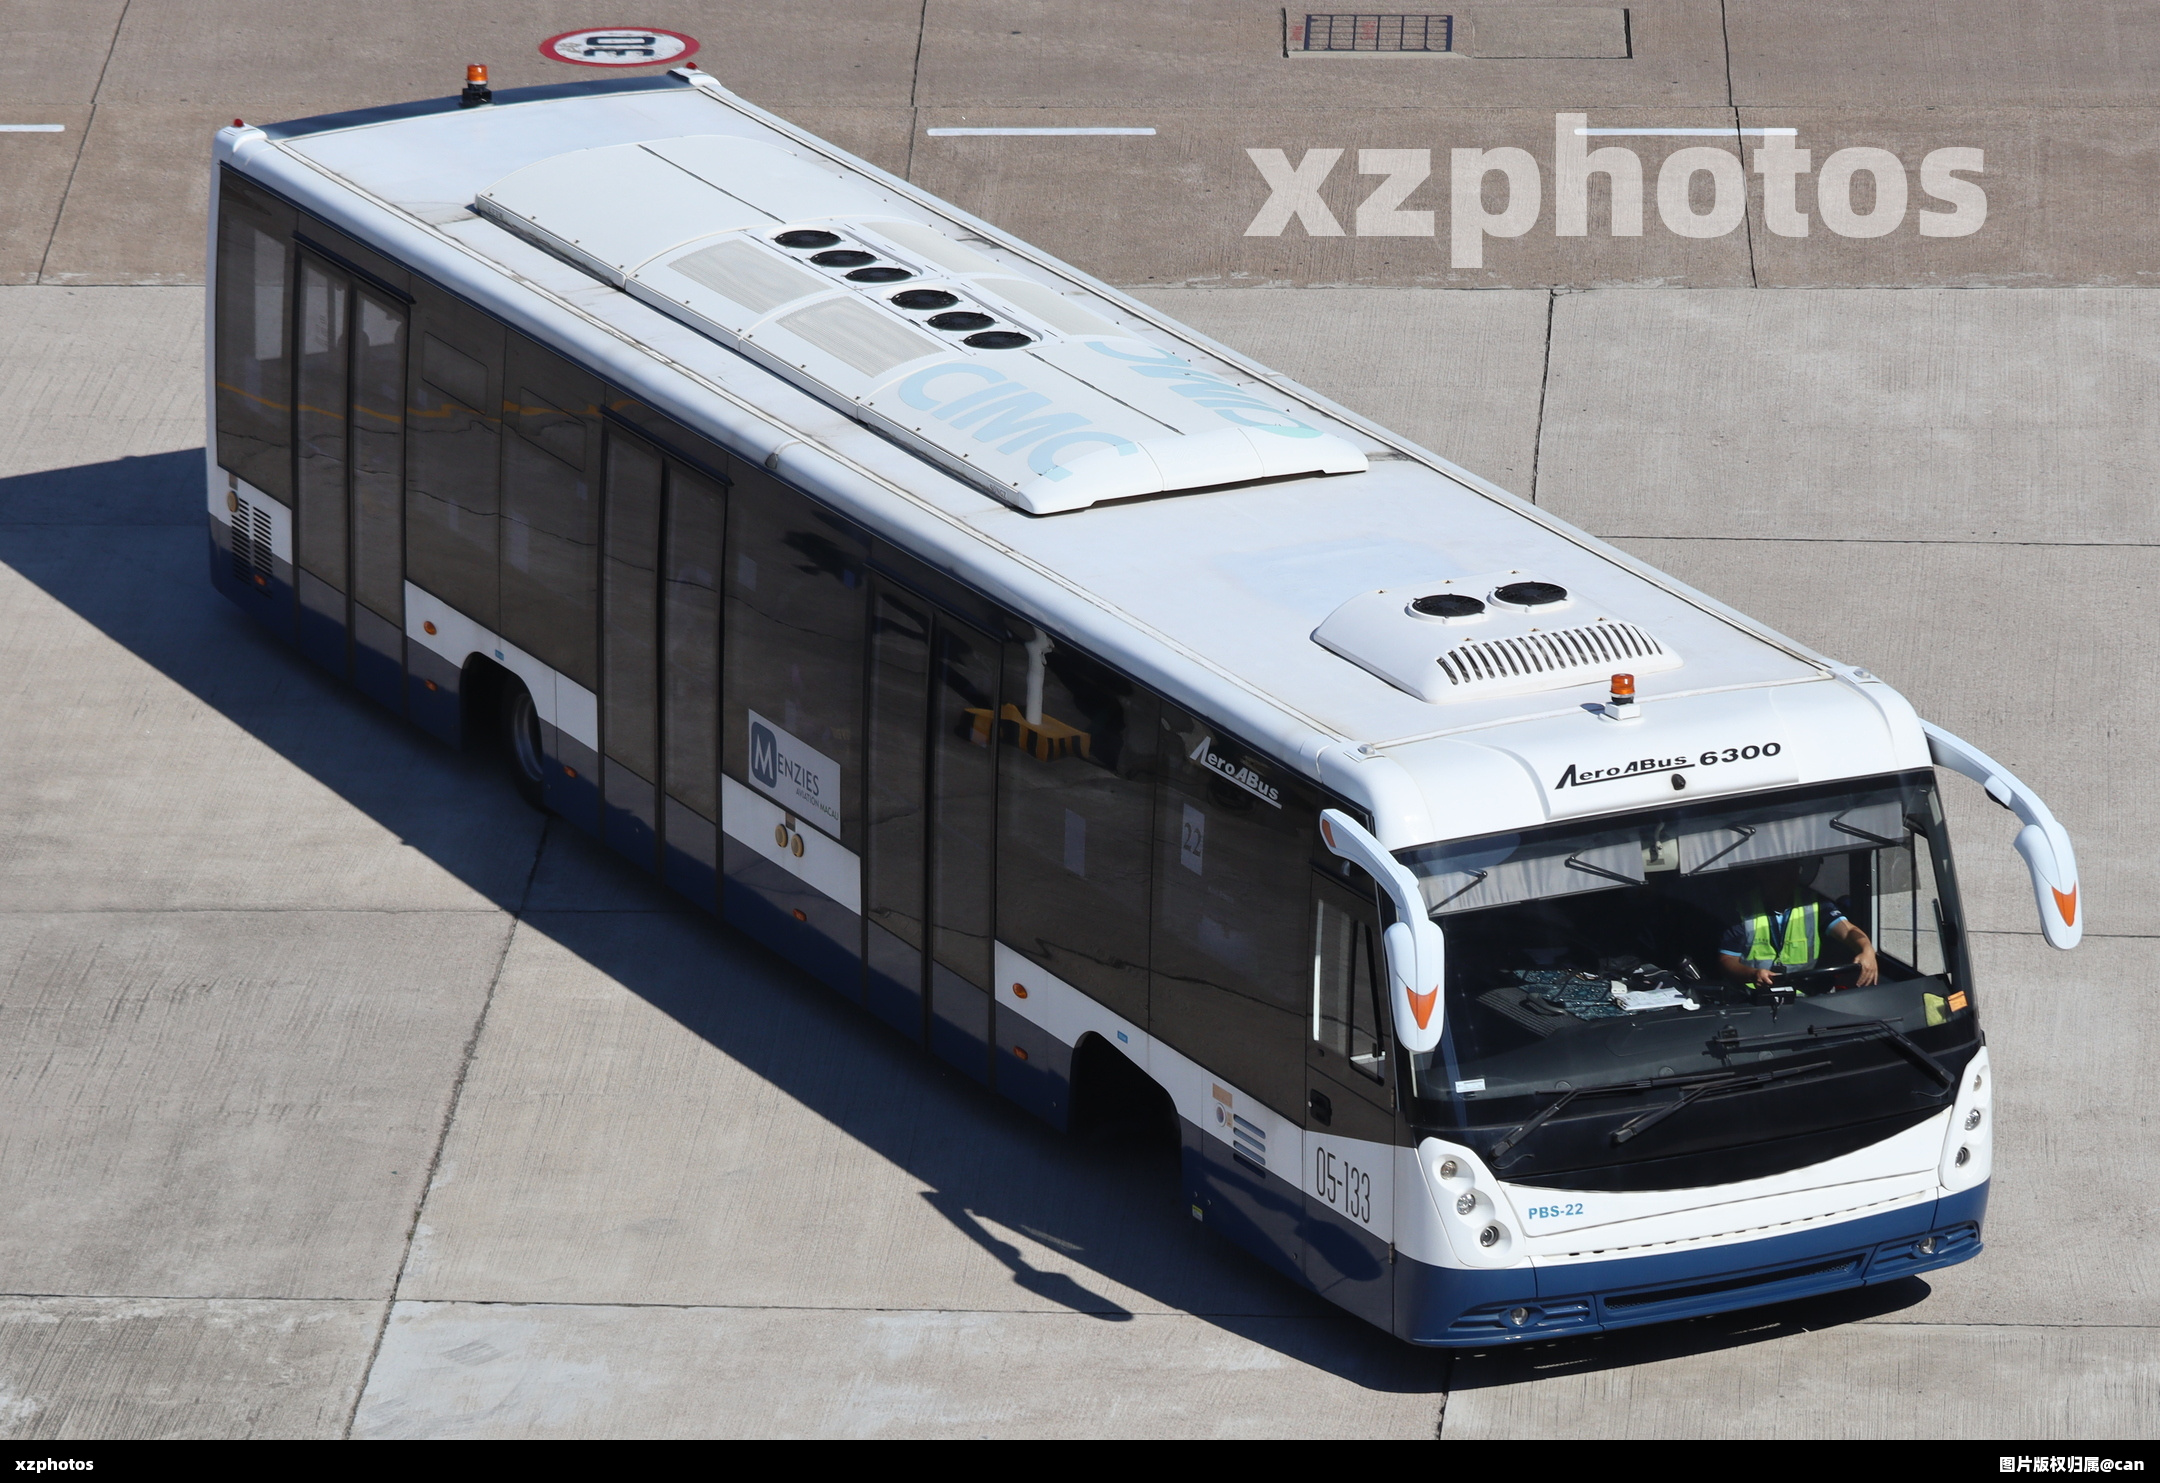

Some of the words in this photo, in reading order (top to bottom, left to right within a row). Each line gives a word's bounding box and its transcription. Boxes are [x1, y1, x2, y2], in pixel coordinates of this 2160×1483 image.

[584, 36, 656, 57] 30
[898, 362, 1139, 483] CIMC
[754, 733, 820, 797] MENZIES
[1699, 742, 1782, 766] 6300
[795, 787, 820, 809] AVIATION
[819, 803, 839, 821] MACAU
[1183, 822, 1202, 857] 22
[1316, 1146, 1371, 1224] 05-133
[1528, 1202, 1584, 1220] PBS-22
